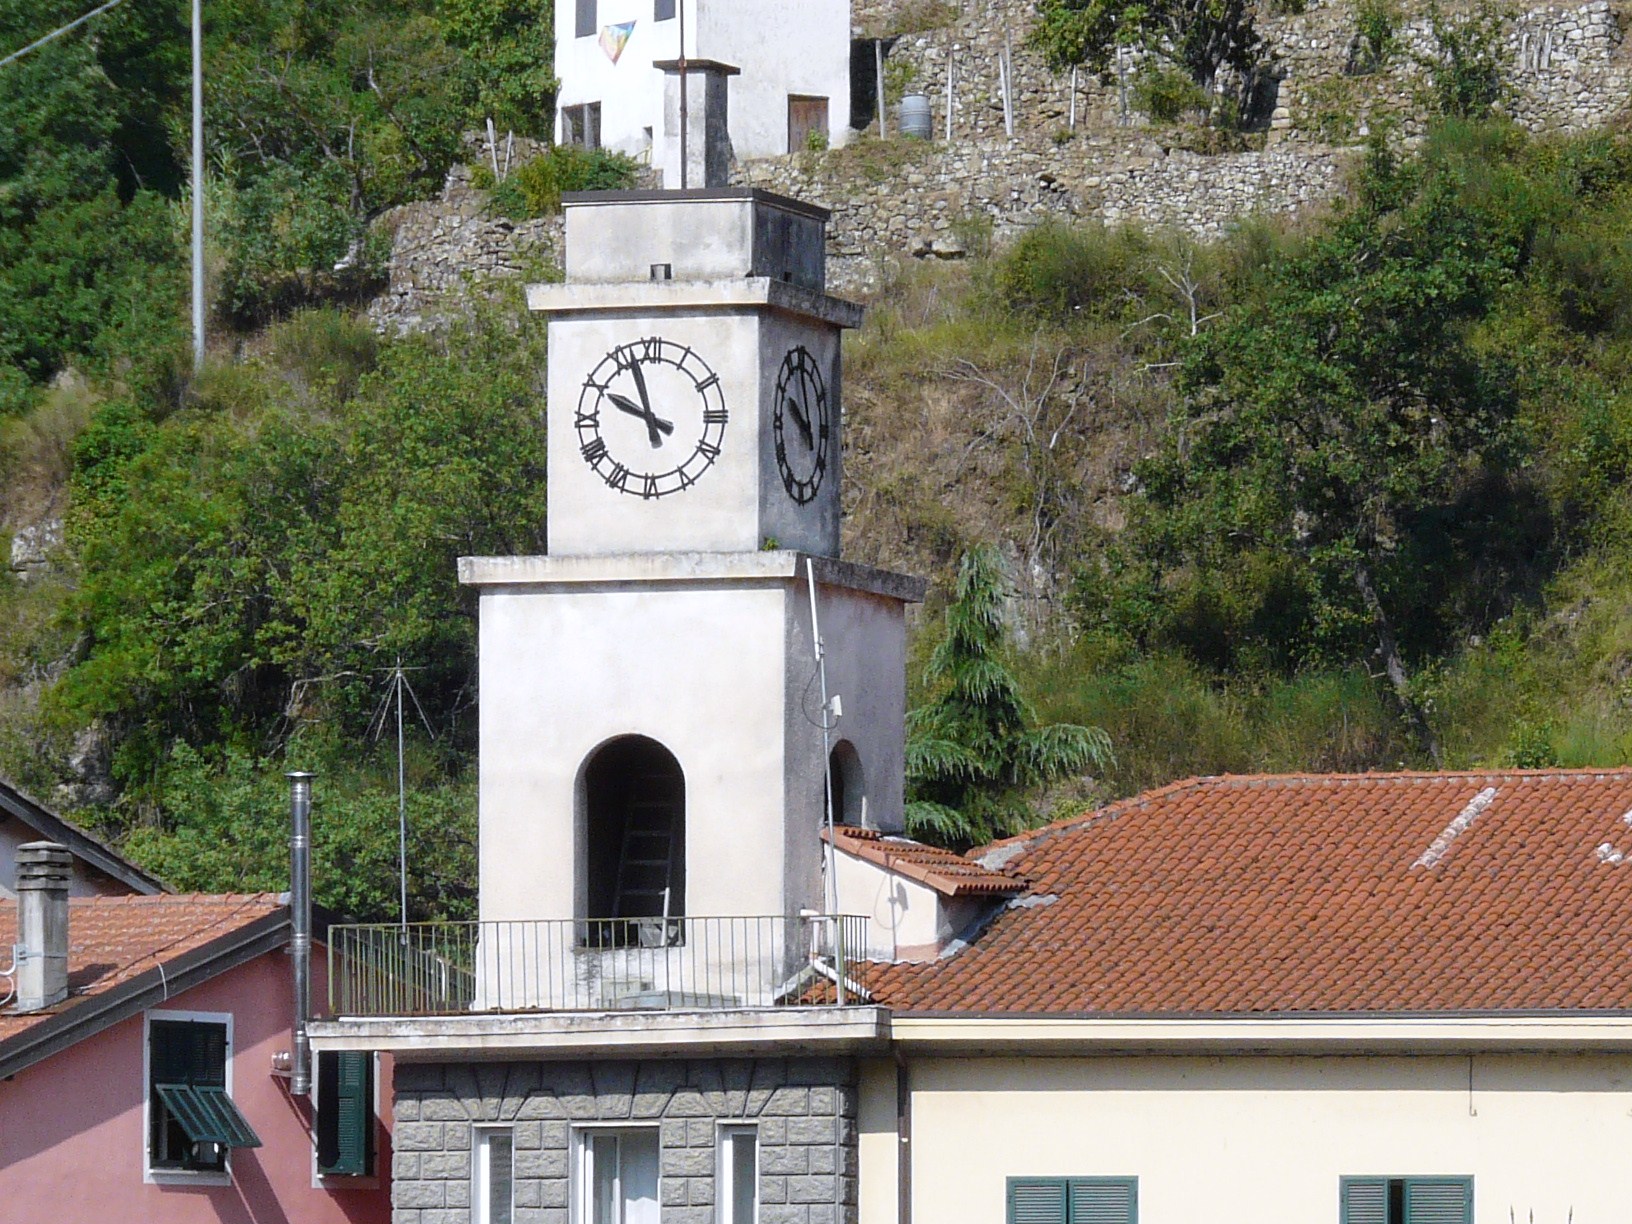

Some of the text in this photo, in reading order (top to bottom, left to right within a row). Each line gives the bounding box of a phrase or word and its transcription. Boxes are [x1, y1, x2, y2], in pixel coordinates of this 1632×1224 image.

[606, 345, 633, 377] XI
[640, 336, 662, 365] XII
[676, 346, 691, 371] I
[582, 373, 610, 398] X
[695, 372, 720, 393] II
[574, 410, 600, 428] IX
[703, 409, 729, 424] III
[579, 436, 609, 471] VIII
[695, 439, 721, 466] IV
[605, 462, 630, 494] VII
[643, 472, 659, 500] VI
[677, 465, 695, 491] V
